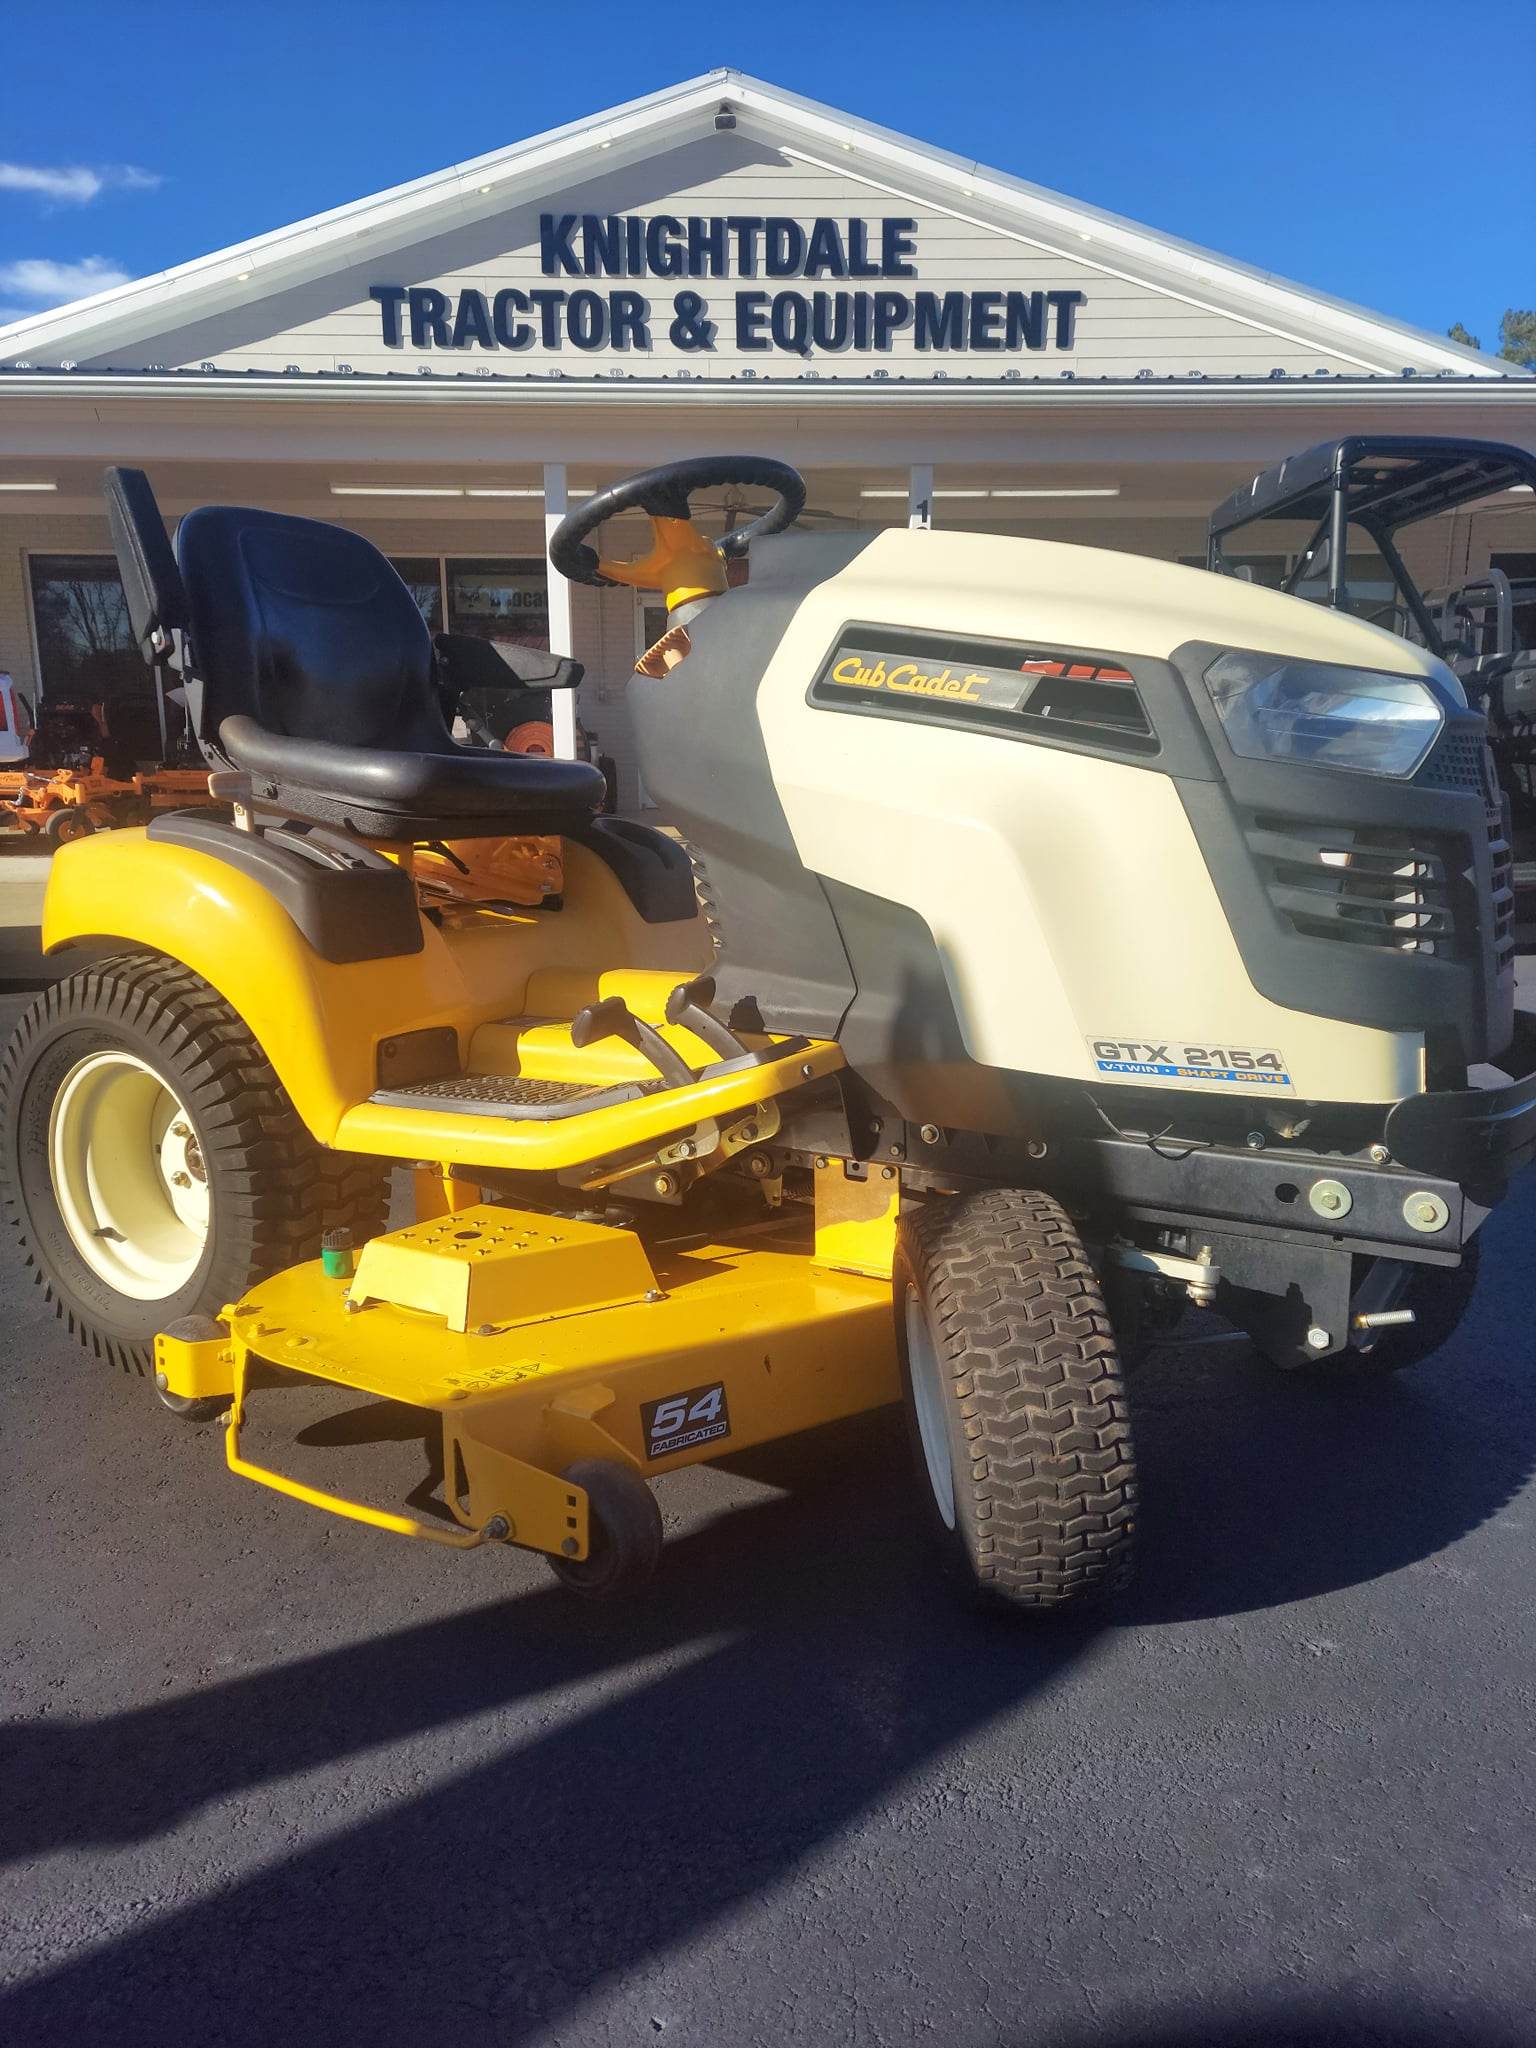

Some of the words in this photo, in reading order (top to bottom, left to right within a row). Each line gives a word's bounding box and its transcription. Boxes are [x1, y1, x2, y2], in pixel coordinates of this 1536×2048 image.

[540, 214, 915, 277] KNIGHTDALE
[369, 286, 649, 350] TRACTOR
[669, 291, 714, 351] &
[736, 291, 1082, 358] EQUIPMENT
[832, 657, 886, 688] Cub
[887, 664, 991, 701] Cadet
[1093, 1041, 1174, 1064] GTX
[1183, 1047, 1283, 1072] 2154
[1103, 1062, 1159, 1075] V-TWIN
[1176, 1068, 1231, 1079] SHAFT
[1235, 1072, 1285, 1084] DRIVE
[650, 1387, 723, 1438] 54
[652, 1423, 726, 1454] FABRICATED
